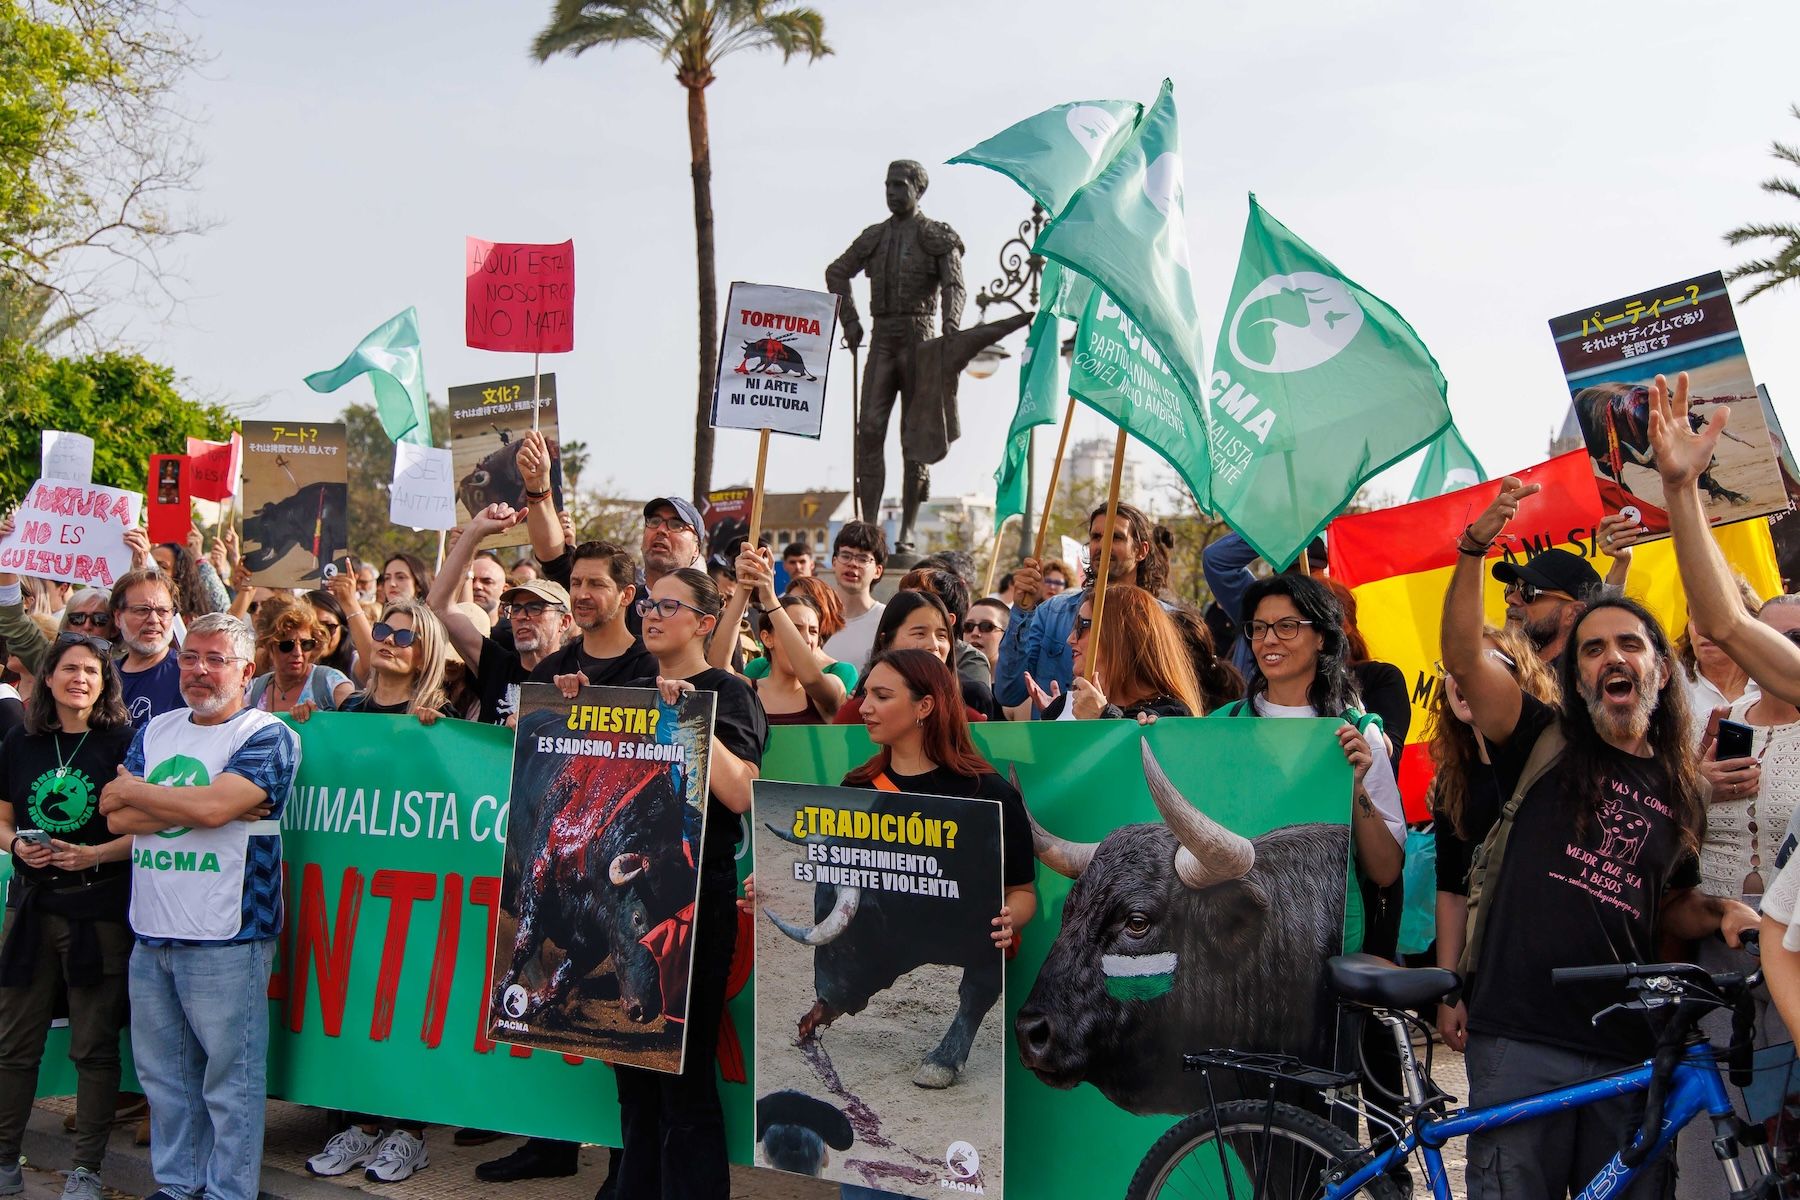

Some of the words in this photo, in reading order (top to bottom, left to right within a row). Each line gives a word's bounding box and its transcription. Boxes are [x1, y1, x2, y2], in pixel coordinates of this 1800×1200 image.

[473, 246, 523, 276] AQUÍ
[472, 304, 512, 337] NO
[741, 310, 820, 336] TORTURA
[1582, 309, 1705, 354] それはサディズムであり
[1621, 334, 1670, 358] 苦悶です
[746, 378, 760, 389] NI
[764, 379, 798, 394] ARTE
[731, 393, 745, 405] NI
[750, 394, 809, 412] CULTURA
[34, 484, 131, 526] TORTURA
[20, 520, 52, 544] NO
[60, 524, 85, 544] ES
[1, 547, 114, 586] CULTURA
[567, 704, 660, 735] ¿FIESTA?
[537, 736, 554, 753] ES
[555, 737, 615, 759] SADISMO,
[618, 742, 635, 759] ES
[636, 742, 685, 762] AGONÍA
[1611, 779, 1629, 795] VAS
[1632, 791, 1639, 802] A
[793, 806, 958, 849] ¿TRADICIÓN?
[808, 843, 828, 863] ES
[830, 845, 943, 878] SUFRIMIENTO,
[1565, 843, 1598, 867] MEJOR
[1601, 861, 1622, 878] QUE
[1625, 872, 1641, 889] SEA
[794, 862, 814, 882] ES
[816, 865, 880, 889] MUERTE
[881, 872, 960, 899] VIOLENTA
[1580, 867, 1587, 878] A
[1589, 872, 1623, 894] BESOS
[498, 1020, 529, 1033] PACMA
[941, 1178, 984, 1195] PACMA
